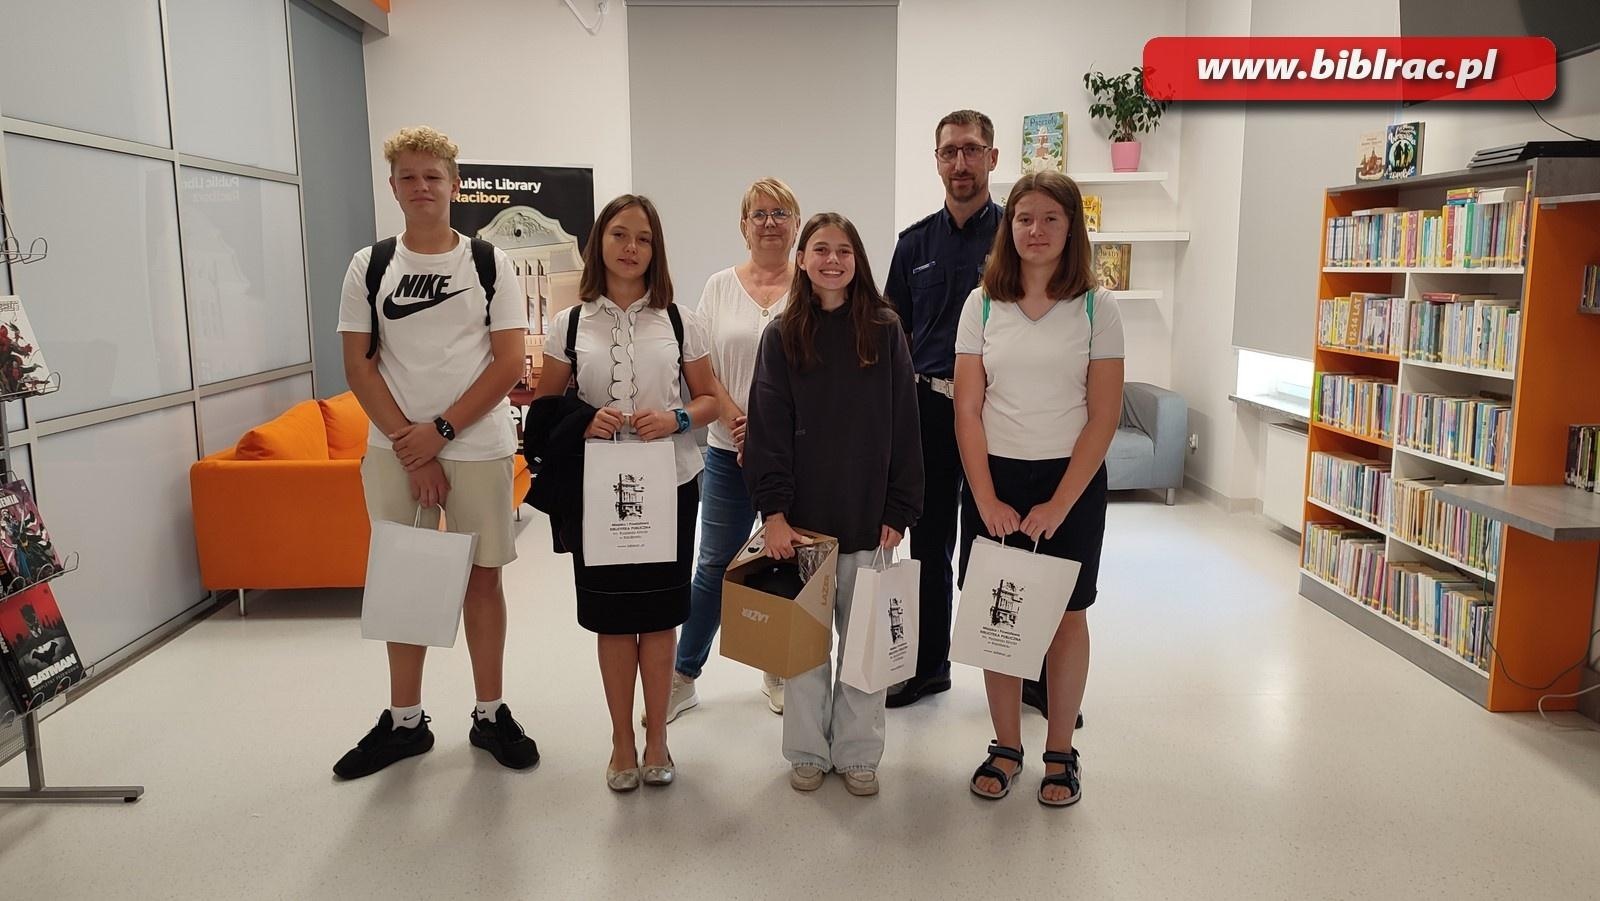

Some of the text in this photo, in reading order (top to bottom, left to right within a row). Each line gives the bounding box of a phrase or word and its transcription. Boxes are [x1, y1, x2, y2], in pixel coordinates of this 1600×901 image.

[459, 177, 541, 194] ublic Library
[451, 191, 511, 204] Raciborz
[394, 273, 452, 300] NIKE
[1352, 297, 1362, 315] LAT
[821, 575, 830, 606] LAZER
[741, 607, 769, 624] LAZER
[27, 653, 77, 688] BATMAN
